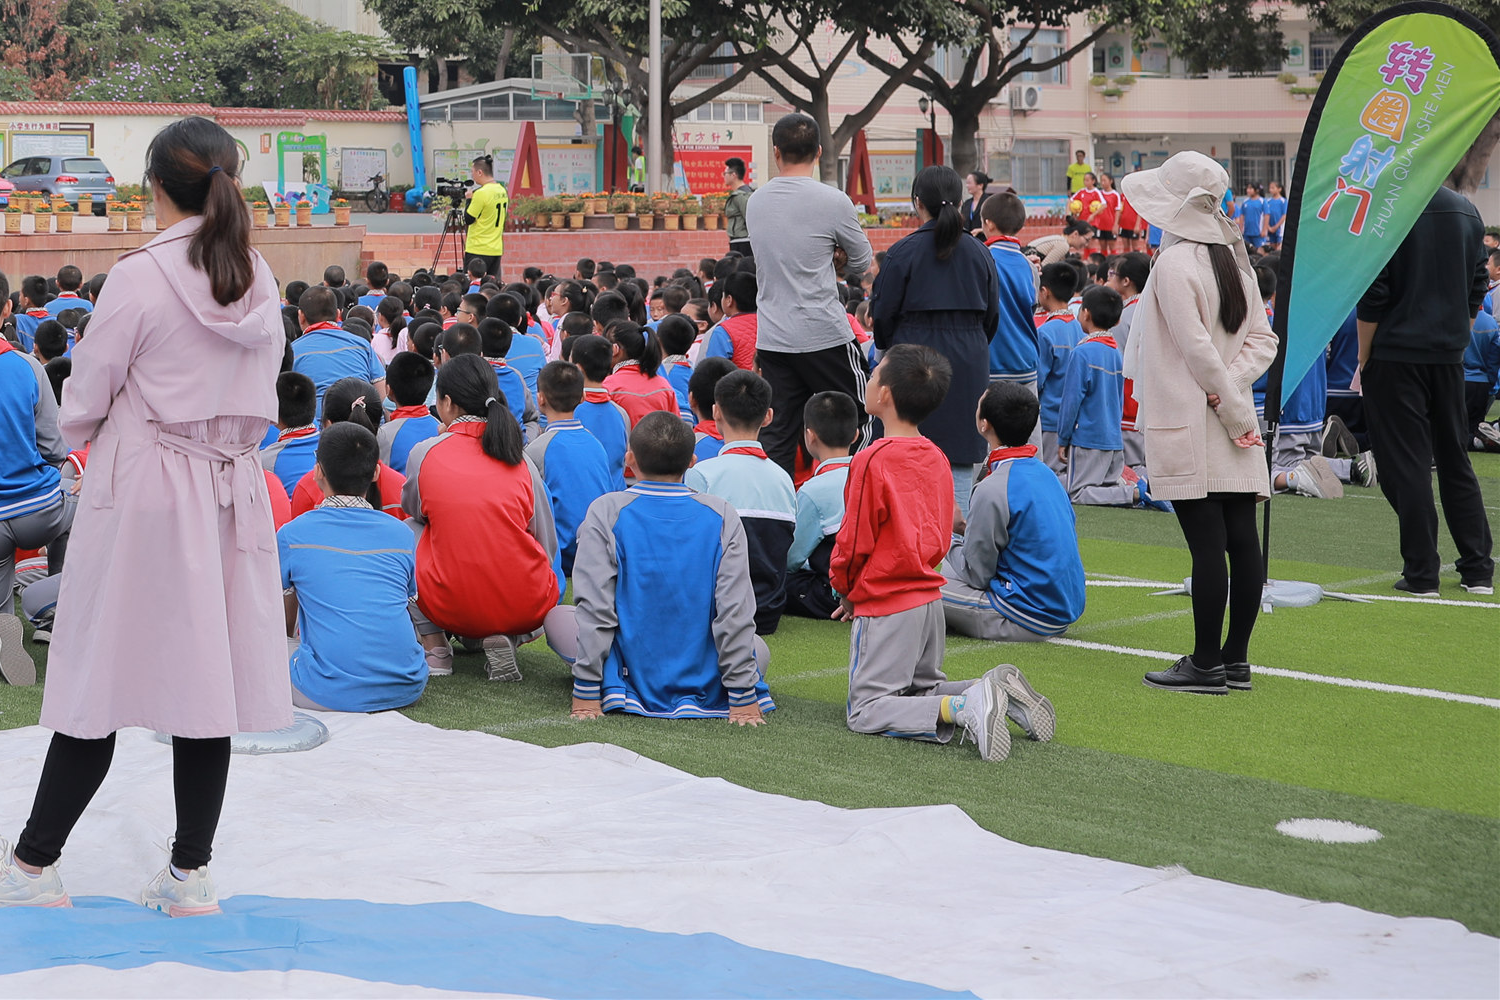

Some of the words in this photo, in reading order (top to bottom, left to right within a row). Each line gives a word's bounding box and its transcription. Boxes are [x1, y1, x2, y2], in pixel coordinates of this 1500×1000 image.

[1316, 41, 1435, 236] 转圈射门
[1370, 183, 1404, 238] ZHUAN
[1393, 133, 1425, 180] QUAN
[1416, 102, 1439, 132] SHE
[1431, 62, 1455, 101] MEN
